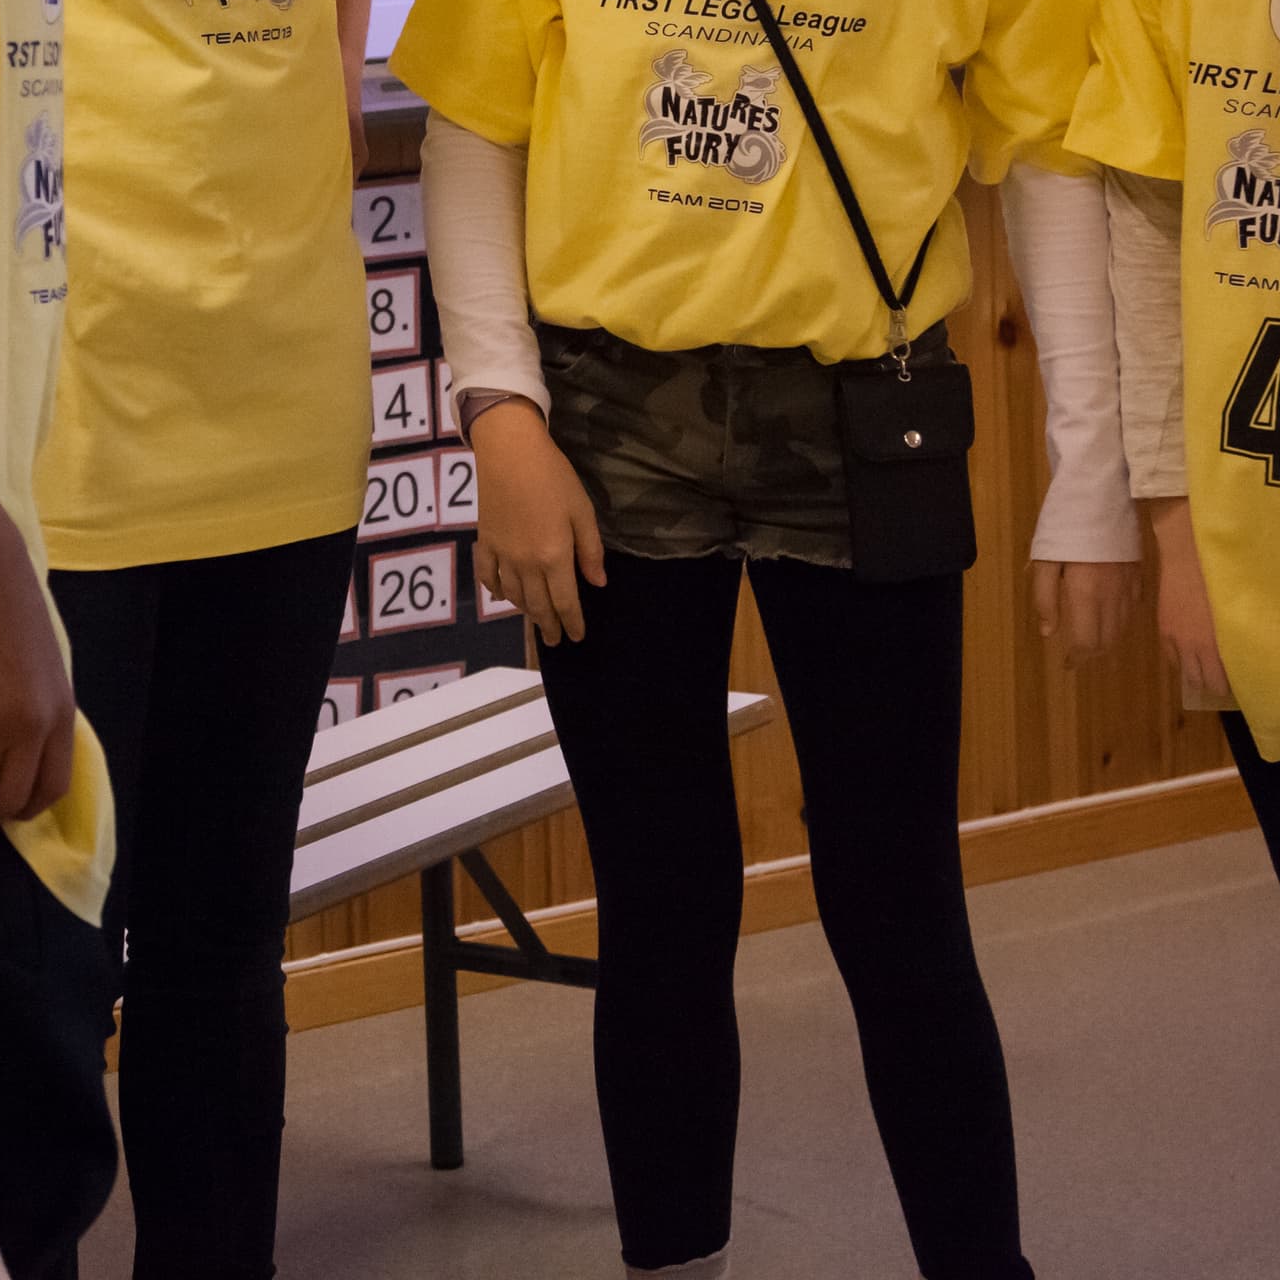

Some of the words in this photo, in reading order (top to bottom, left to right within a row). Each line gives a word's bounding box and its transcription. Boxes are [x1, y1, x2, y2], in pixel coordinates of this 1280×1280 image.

[776, 5, 867, 37] League
[201, 30, 258, 46] TEAM
[262, 26, 292, 42] 2013
[668, 133, 742, 165] FURY
[647, 189, 702, 207] TEAM
[708, 197, 764, 214] 2013
[1215, 272, 1279, 291] TEAM
[379, 566, 447, 618] 26.
